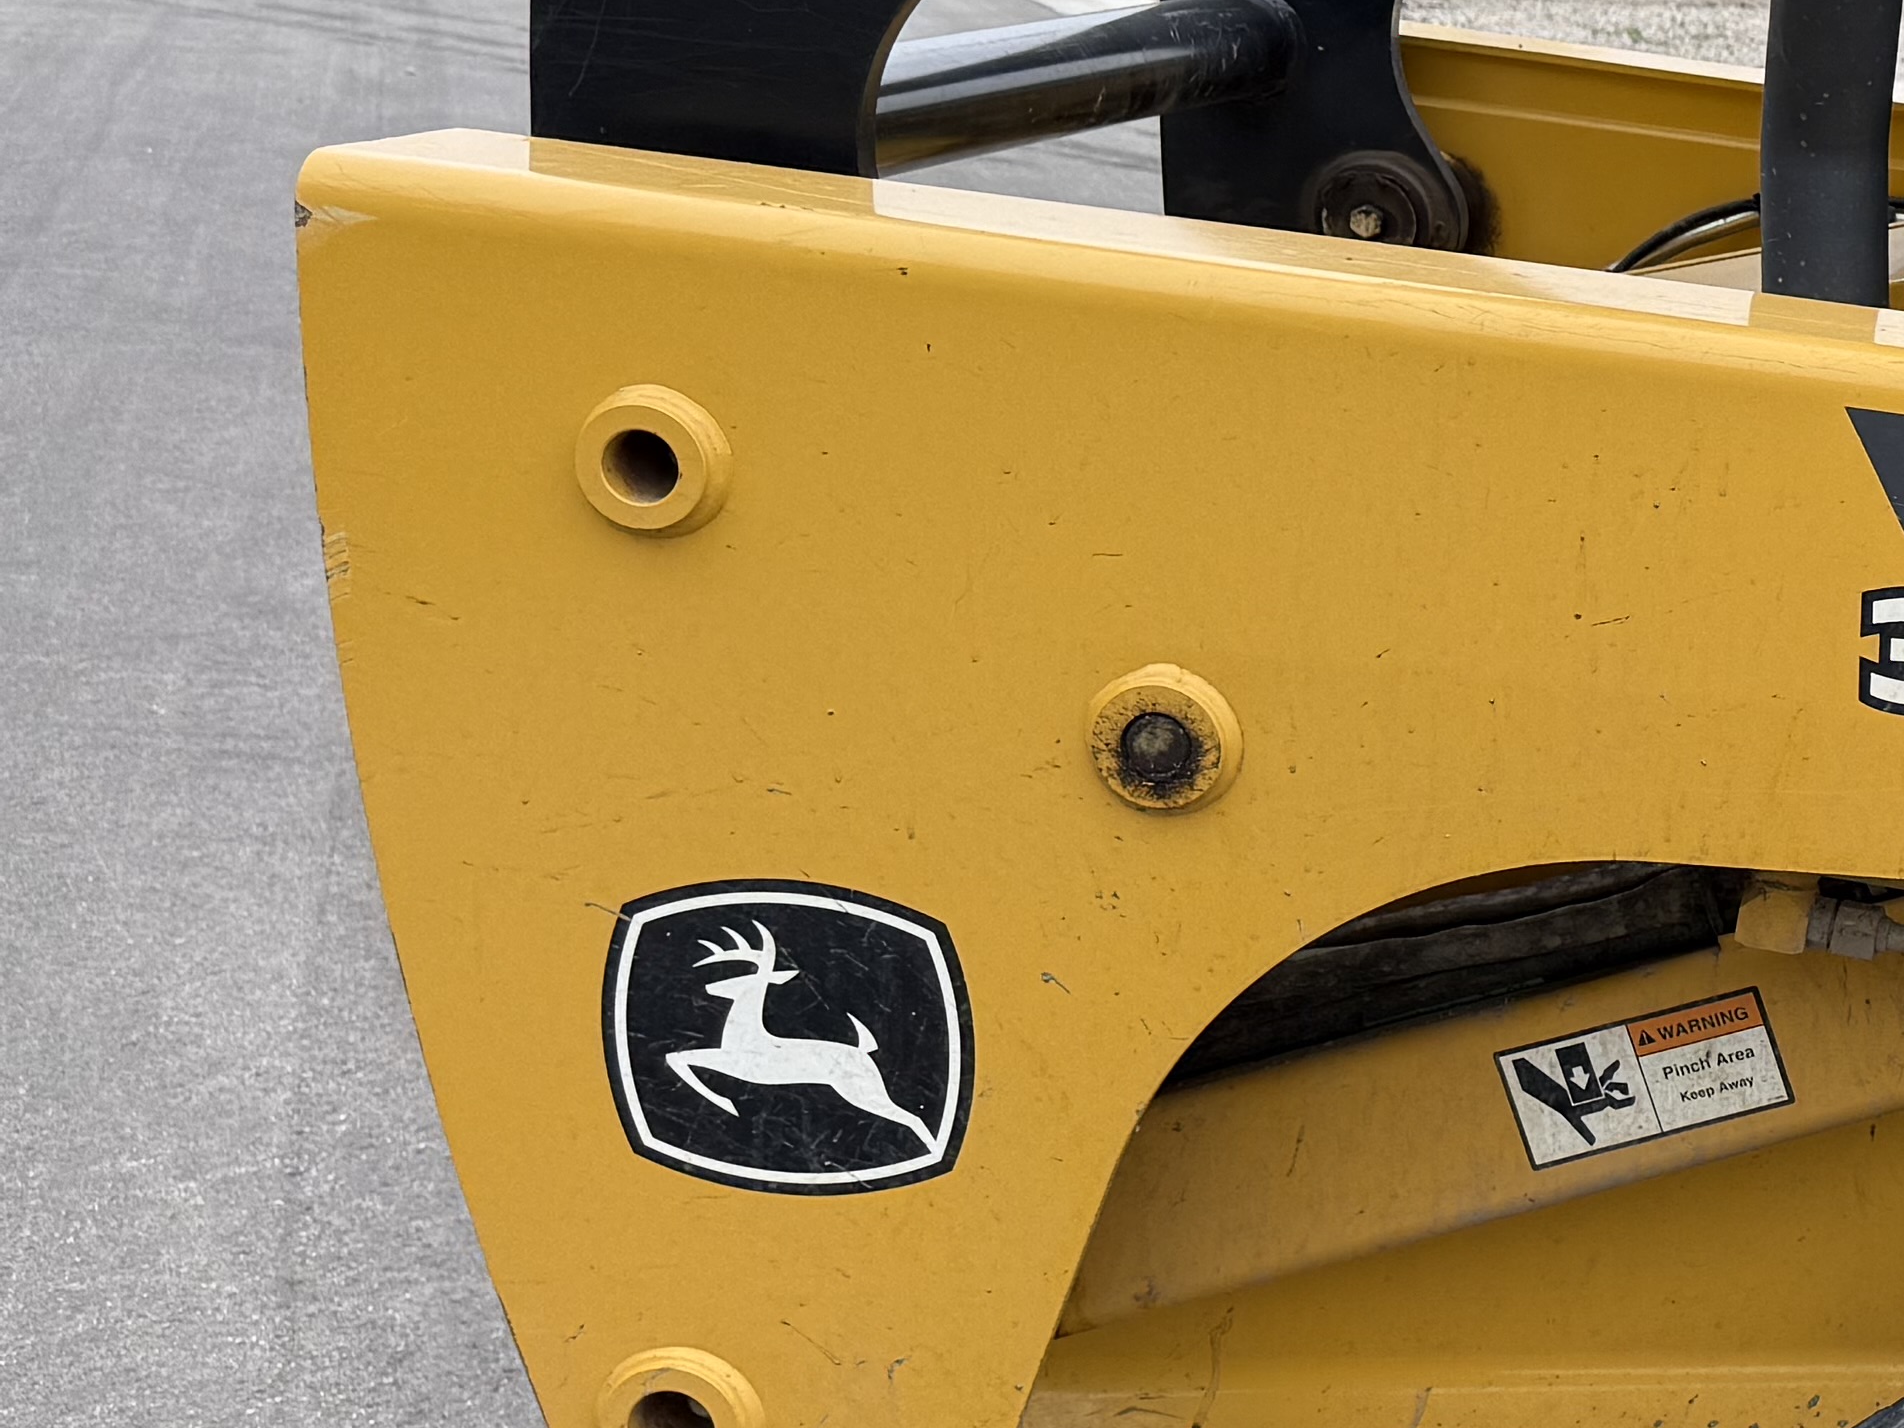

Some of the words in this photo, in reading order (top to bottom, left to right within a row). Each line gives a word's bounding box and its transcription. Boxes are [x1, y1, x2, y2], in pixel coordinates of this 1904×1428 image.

[1656, 1006, 1750, 1041] WARNING
[1662, 1058, 1710, 1080] Pinch
[1717, 1047, 1755, 1067] Area
[1680, 1086, 1715, 1103] Keep
[1720, 1076, 1754, 1094] Away
